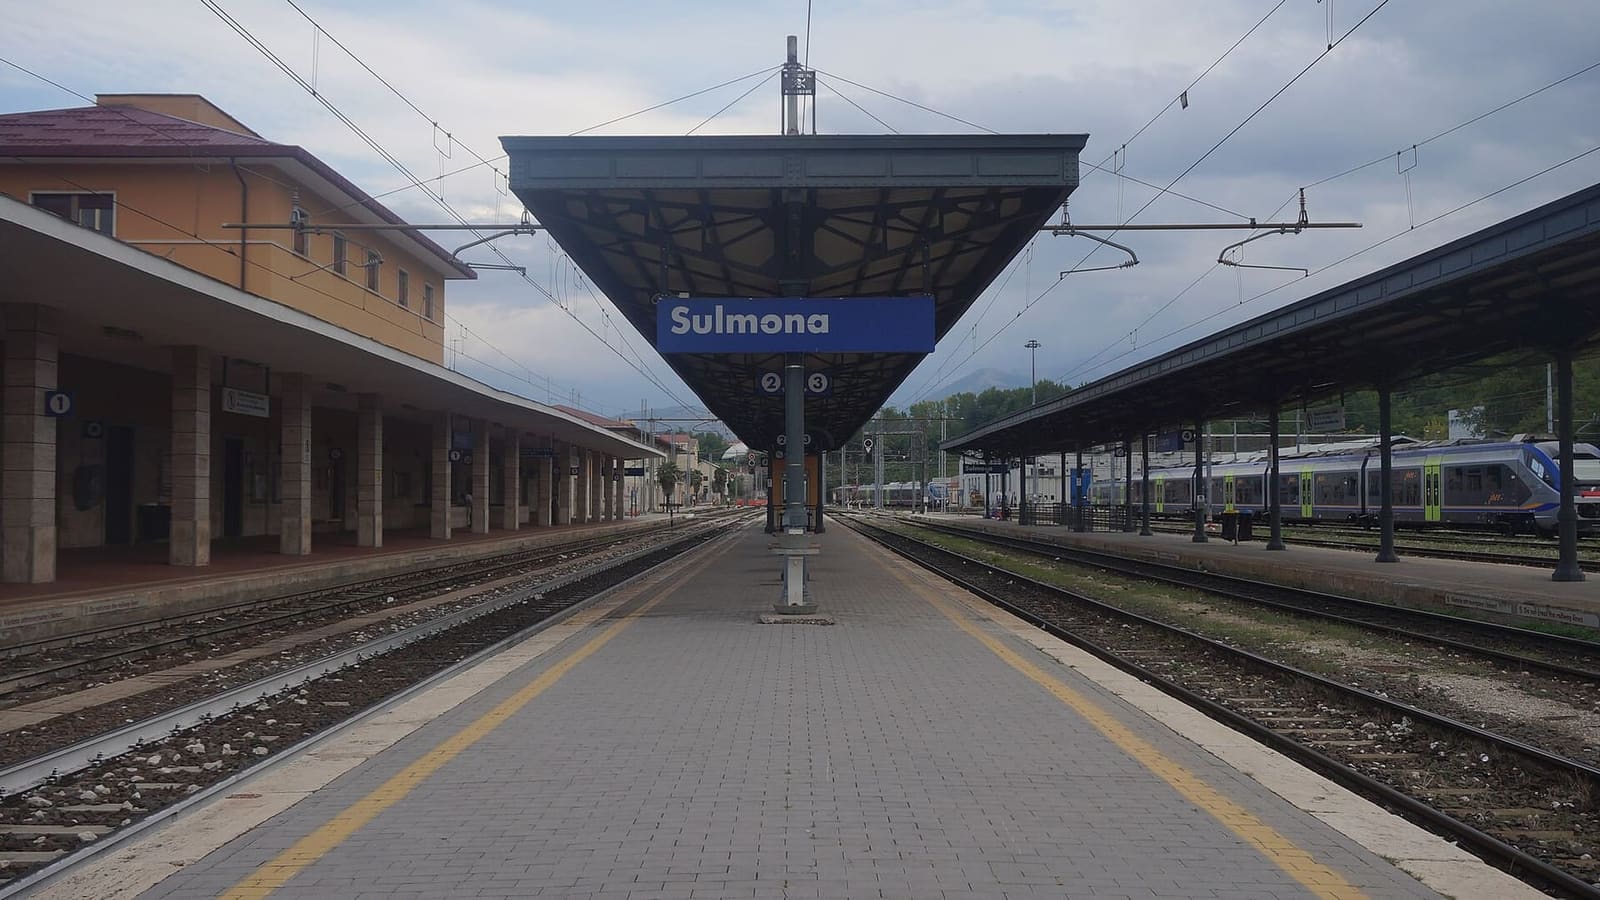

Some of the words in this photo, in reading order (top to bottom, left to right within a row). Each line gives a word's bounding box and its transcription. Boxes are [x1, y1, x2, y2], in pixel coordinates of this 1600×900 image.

[670, 304, 829, 334] Sulmona
[766, 376, 777, 389] 2
[813, 376, 823, 389] 3
